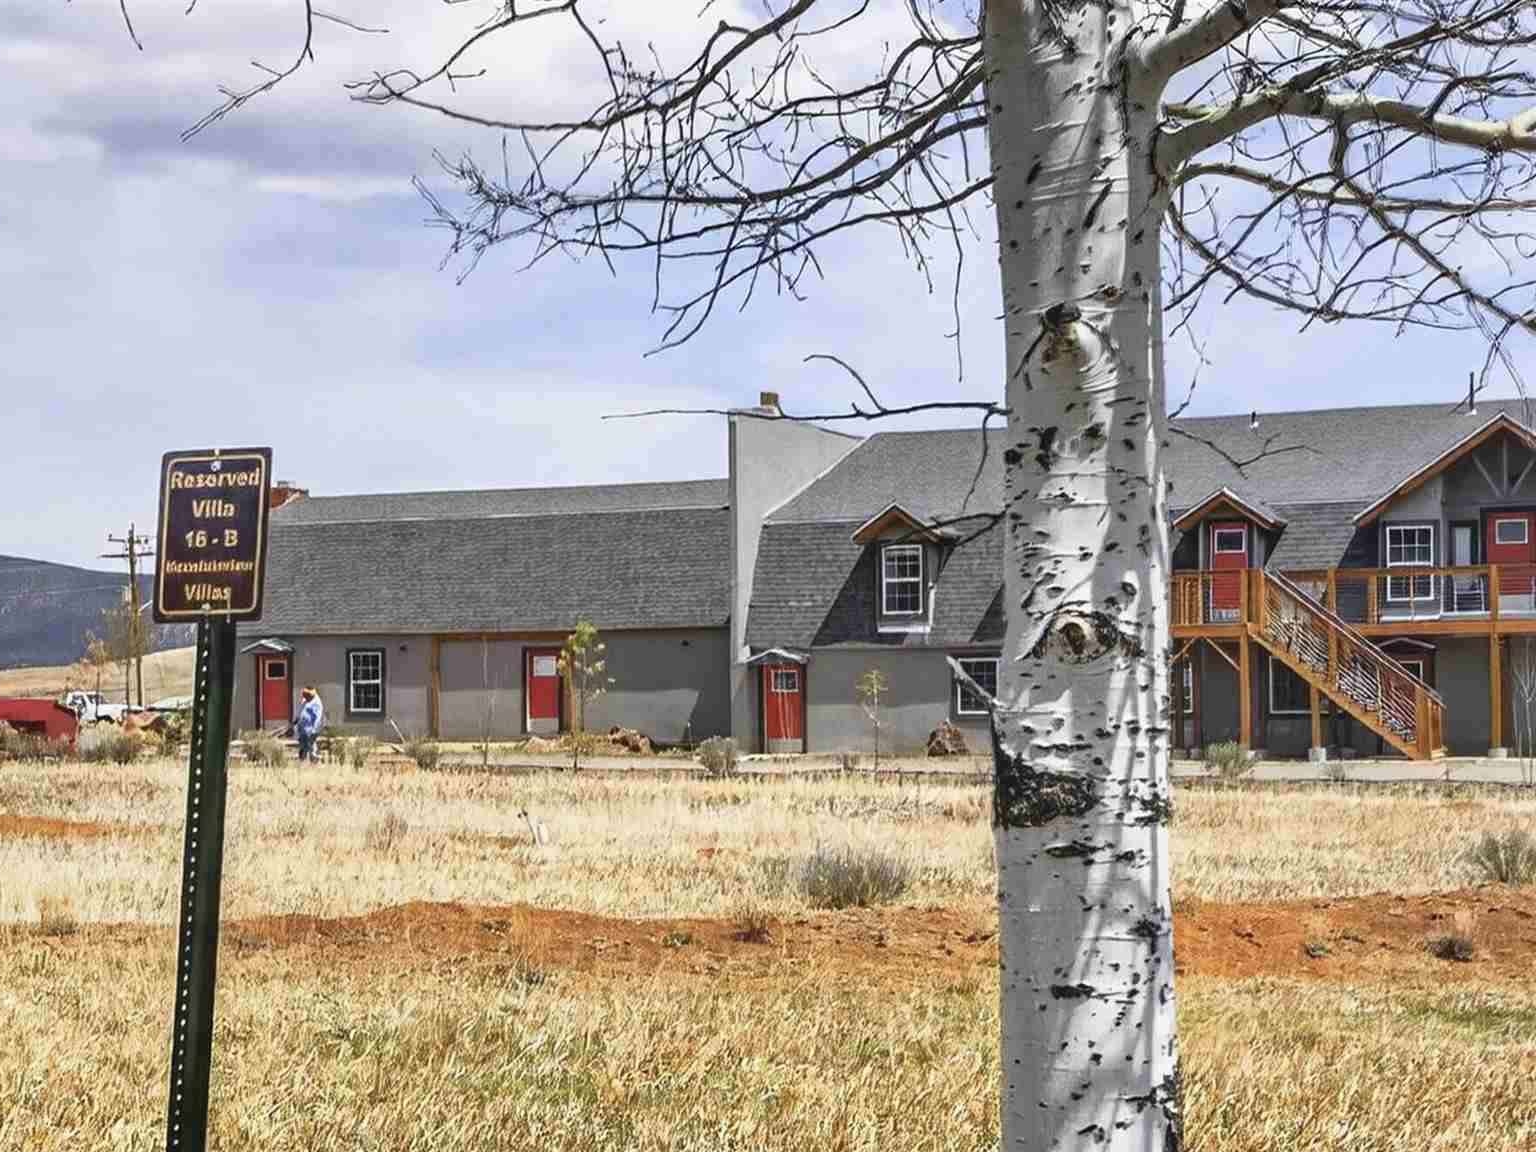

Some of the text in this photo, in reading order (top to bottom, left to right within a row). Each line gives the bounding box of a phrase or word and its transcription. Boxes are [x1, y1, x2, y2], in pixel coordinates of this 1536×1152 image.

[170, 467, 260, 489] Reserved
[192, 499, 235, 518] Villa
[185, 530, 208, 549] 16
[223, 528, 239, 548] B
[184, 583, 232, 601] Villas
